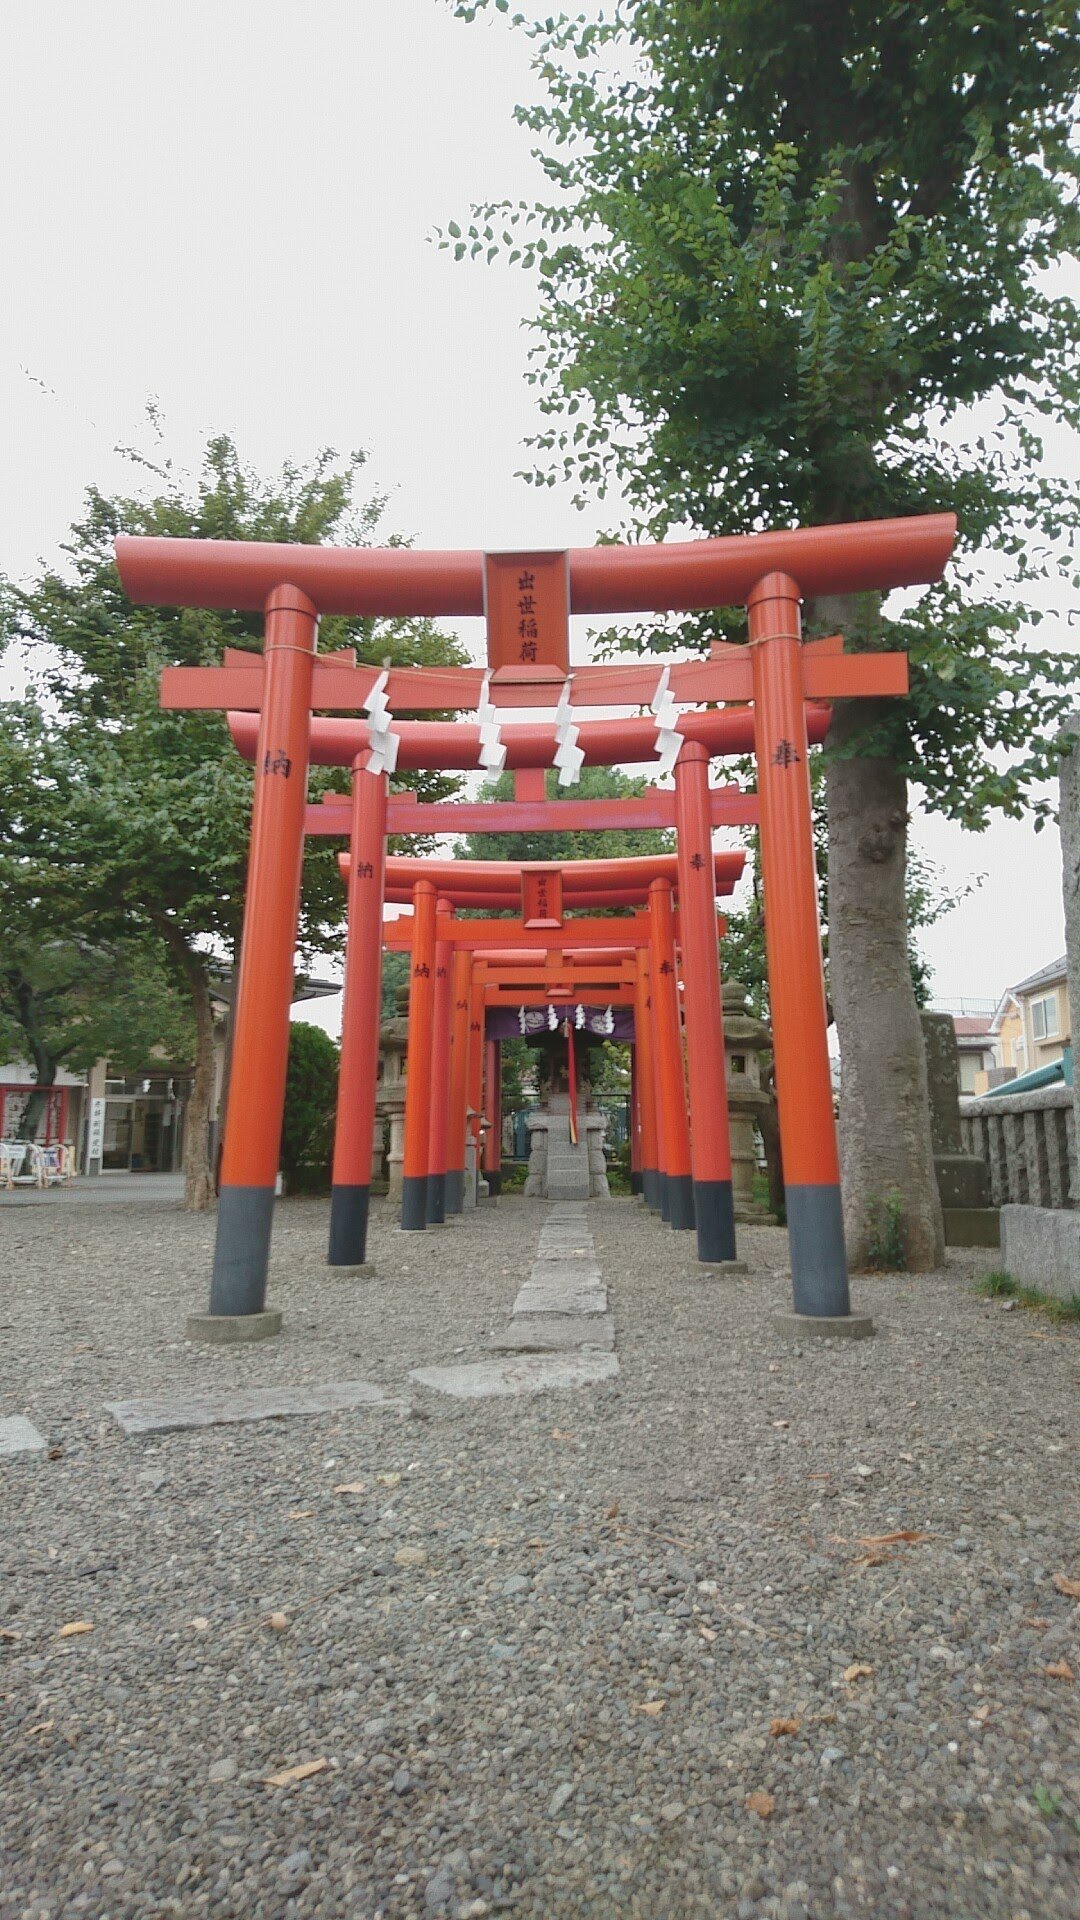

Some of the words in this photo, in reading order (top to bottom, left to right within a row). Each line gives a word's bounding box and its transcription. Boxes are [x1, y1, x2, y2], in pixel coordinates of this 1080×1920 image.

[517, 570, 538, 662] 出世稲荷
[264, 749, 292, 779] 納
